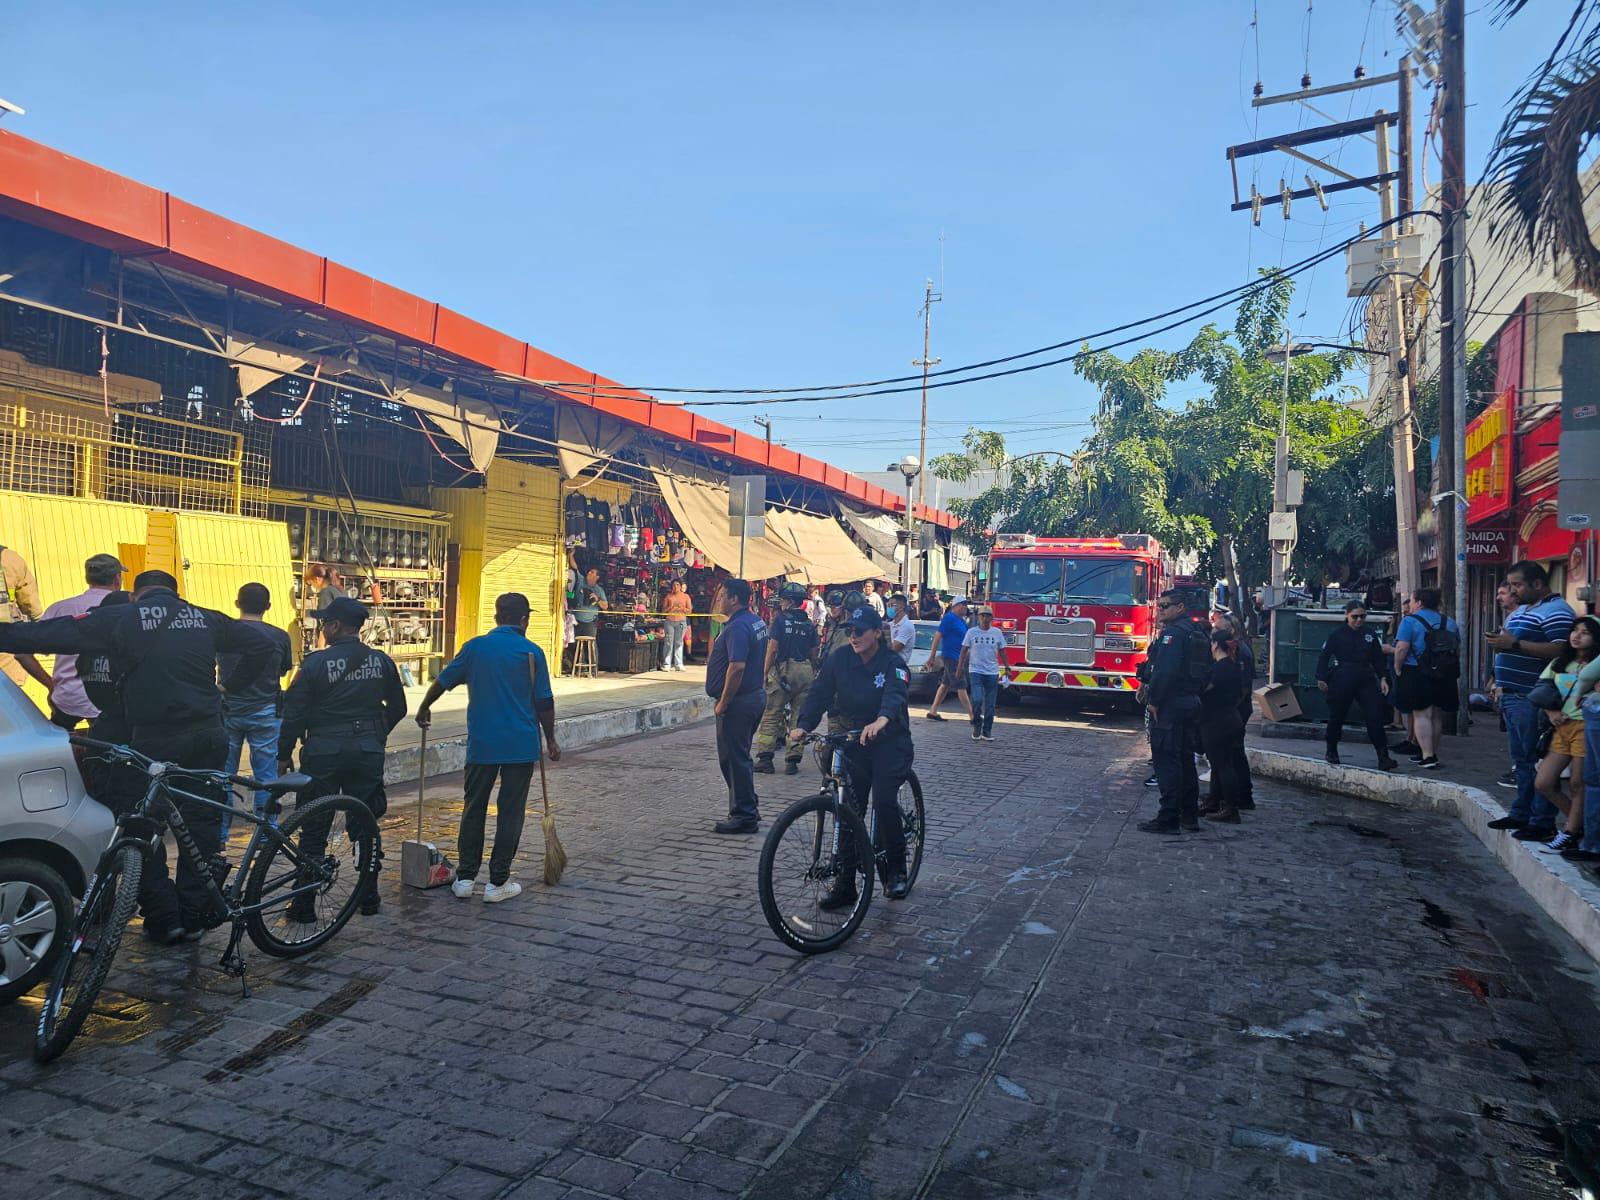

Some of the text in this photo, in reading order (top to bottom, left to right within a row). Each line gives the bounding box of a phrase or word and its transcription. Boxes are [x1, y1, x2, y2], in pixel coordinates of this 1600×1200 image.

[1465, 531, 1505, 541] OMIDA
[1466, 544, 1499, 554] HINA
[139, 606, 205, 619] POCÍA
[1044, 604, 1081, 617] M-73
[142, 619, 207, 631] MUICIPAL
[326, 655, 382, 671] POCÍA
